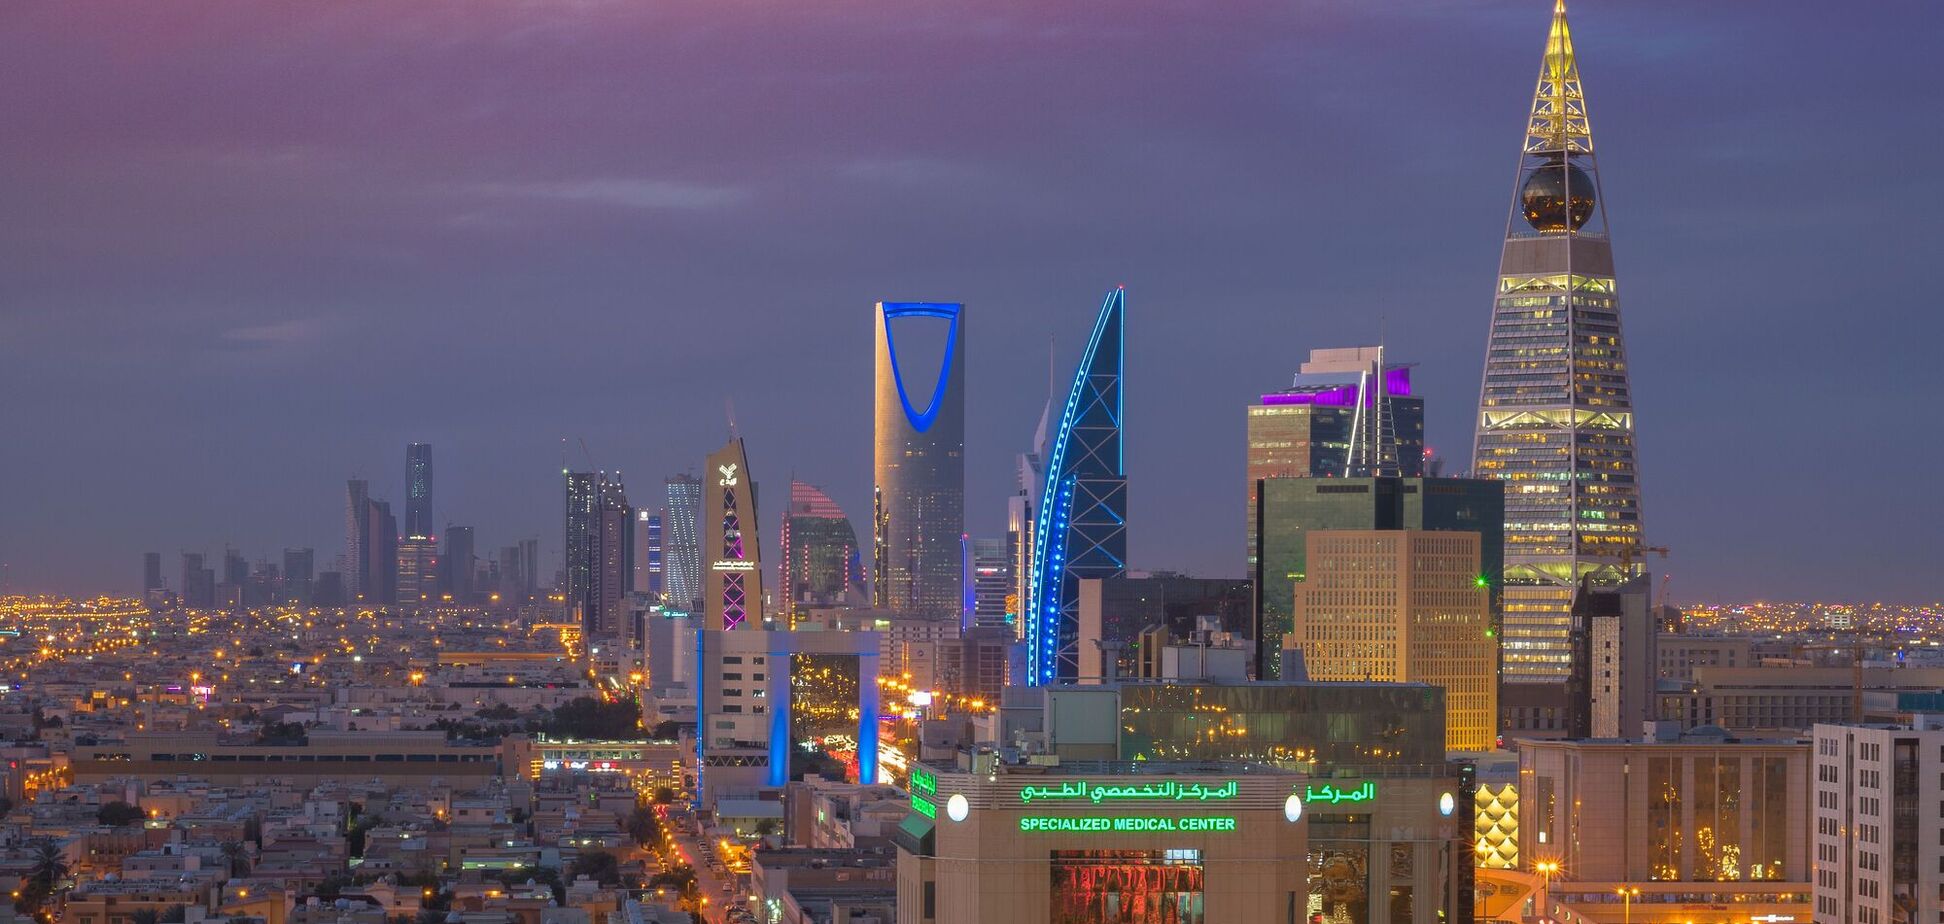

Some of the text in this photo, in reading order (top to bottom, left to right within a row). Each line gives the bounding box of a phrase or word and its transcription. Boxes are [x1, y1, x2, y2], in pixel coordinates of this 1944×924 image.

[1020, 781, 1237, 803] المركز التخصصي الطبي
[1305, 782, 1374, 804] المركز
[1020, 817, 1236, 831] SPECIALIZED MEDICAL CENTER
